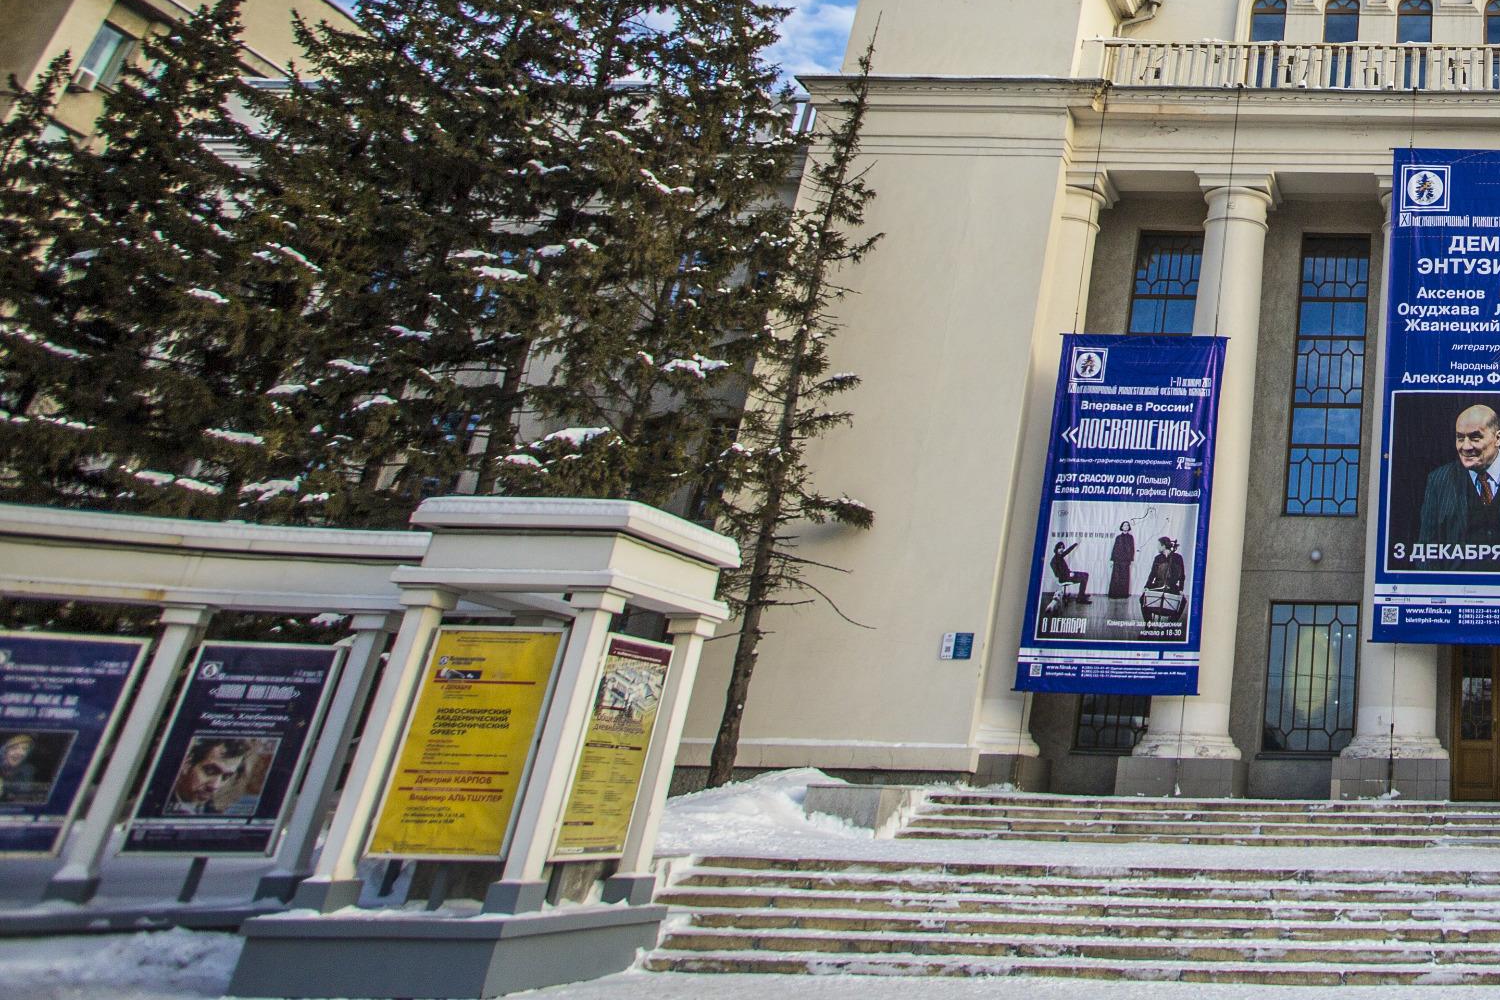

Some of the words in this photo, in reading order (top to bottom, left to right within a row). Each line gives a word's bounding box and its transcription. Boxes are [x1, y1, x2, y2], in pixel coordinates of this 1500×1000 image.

[1416, 288, 1486, 300] Аксенов
[1397, 303, 1480, 317] Окуджава
[1404, 319, 1500, 334] Жванецкий
[1450, 361, 1499, 371] Народный
[1402, 372, 1484, 386] Александр
[1080, 400, 1133, 412] Впервые
[1136, 403, 1143, 411] в
[1145, 402, 1194, 412] России!
[1061, 418, 1206, 451] «ПОСВЯЩЕНИЯ»
[1056, 473, 1077, 484] ДУЭТ
[1078, 474, 1115, 483] CRACOW
[1116, 474, 1135, 484] DUO
[1136, 475, 1171, 486] (Польша)
[1081, 486, 1106, 494] ЛОЛА
[1136, 488, 1167, 496] графика
[1168, 488, 1201, 498] (Польша)
[1394, 544, 1406, 559] 3
[1050, 618, 1087, 634] ДЕКАБРЯ
[436, 707, 512, 715] НОВОСИБИРСКИЙ
